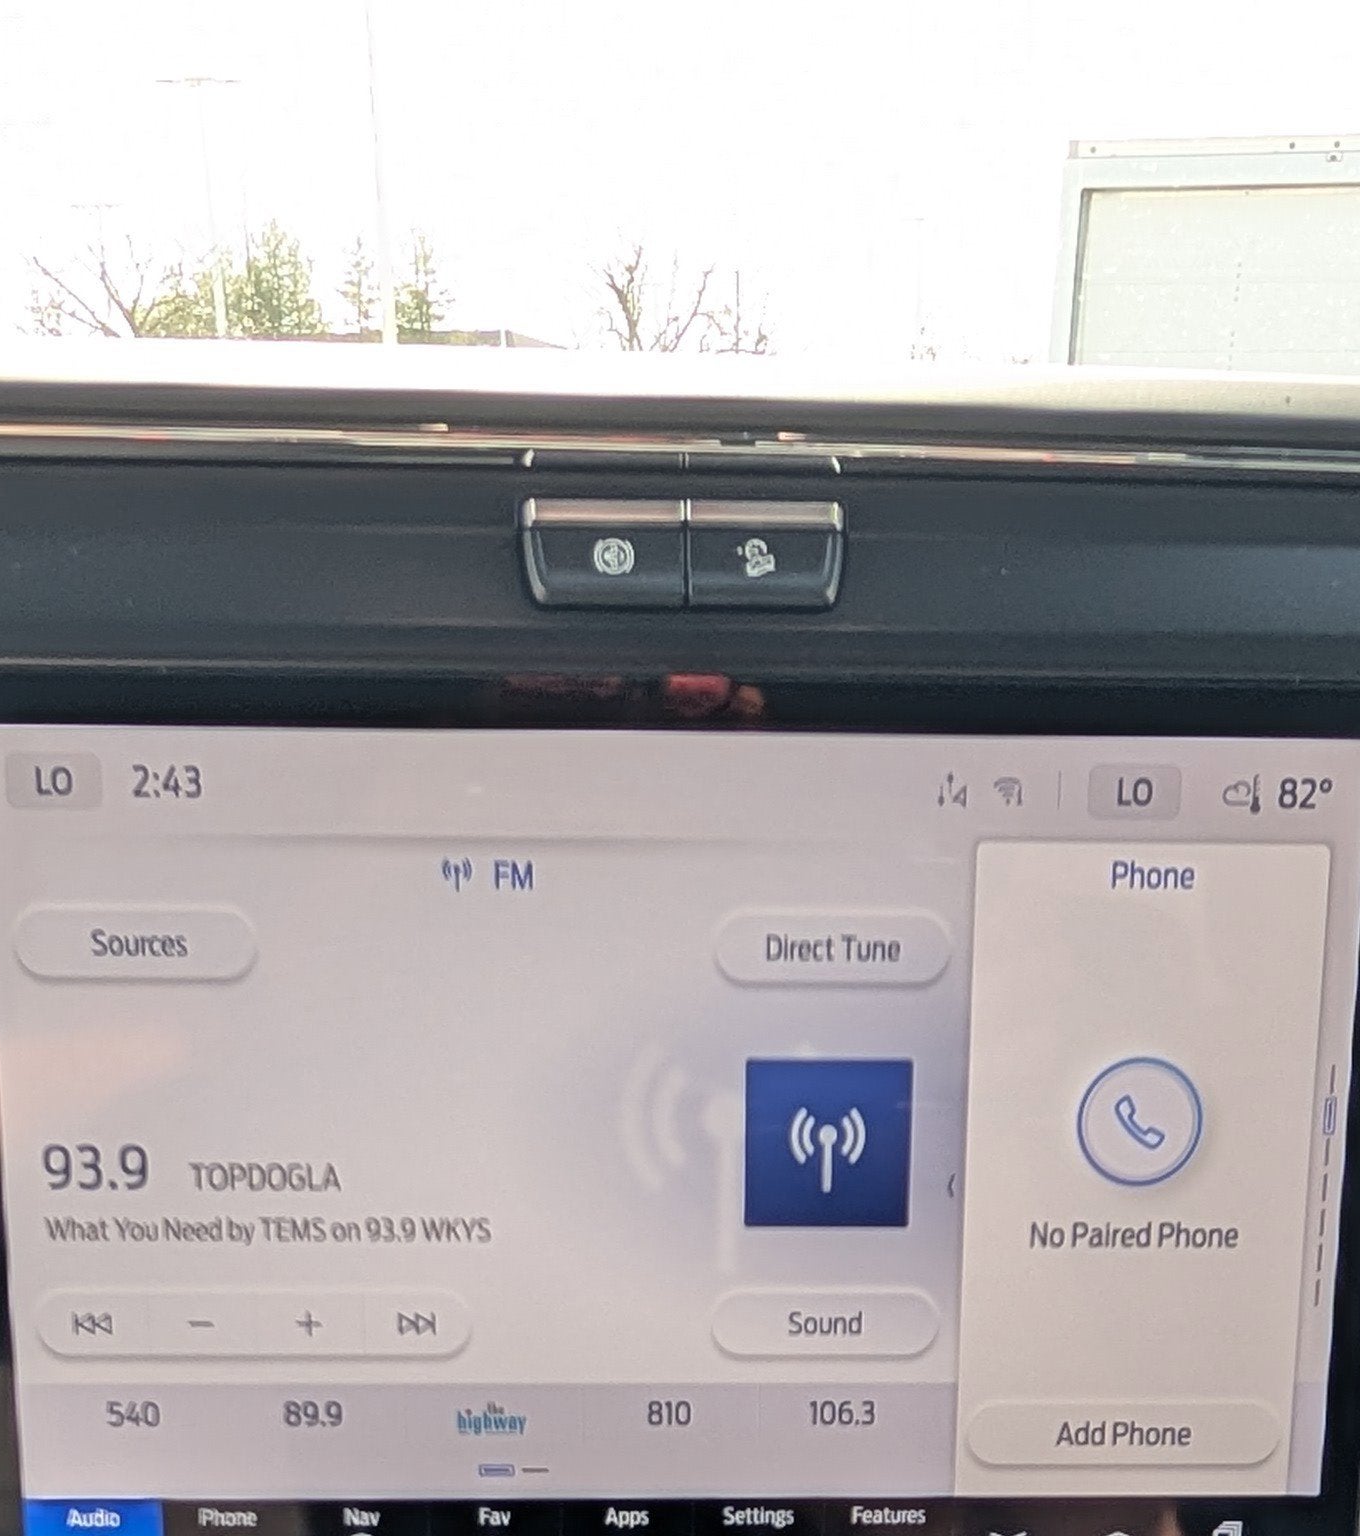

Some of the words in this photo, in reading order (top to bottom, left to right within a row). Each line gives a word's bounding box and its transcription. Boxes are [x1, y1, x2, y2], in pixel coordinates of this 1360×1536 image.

[35, 766, 73, 796] LO
[131, 763, 203, 799] 2:43
[1116, 776, 1154, 807] LO
[493, 861, 534, 891] FM
[1111, 860, 1195, 890] Phone
[91, 928, 188, 958] Sources
[765, 933, 834, 963] Direct
[841, 934, 901, 963] Tune
[42, 1143, 150, 1191] 93.9
[189, 1162, 342, 1192] TOPDOGLA
[44, 1217, 110, 1243] What
[115, 1217, 159, 1243] You
[163, 1216, 223, 1243] Need
[227, 1216, 255, 1247] by
[258, 1217, 327, 1243] TEMS
[331, 1223, 361, 1243] on
[366, 1218, 417, 1243] 93.9
[421, 1217, 492, 1243] WKYS
[1030, 1222, 1067, 1248] No
[1072, 1221, 1153, 1249] Paired
[1159, 1222, 1240, 1249] Phone
[787, 1310, 864, 1337] Sound
[106, 1400, 161, 1428] 540
[283, 1400, 344, 1427] 89.9
[456, 1409, 527, 1436] highway
[646, 1400, 692, 1426] 810
[808, 1400, 876, 1426] 106.3
[1056, 1421, 1108, 1447] Add
[1113, 1421, 1192, 1447] Phone
[67, 1508, 121, 1528] Audio
[198, 1508, 257, 1528] Phone
[344, 1507, 380, 1527] Nav
[479, 1507, 511, 1527] Fav
[605, 1507, 650, 1533] Apps
[723, 1506, 795, 1531] Settings
[852, 1505, 926, 1525] Features
